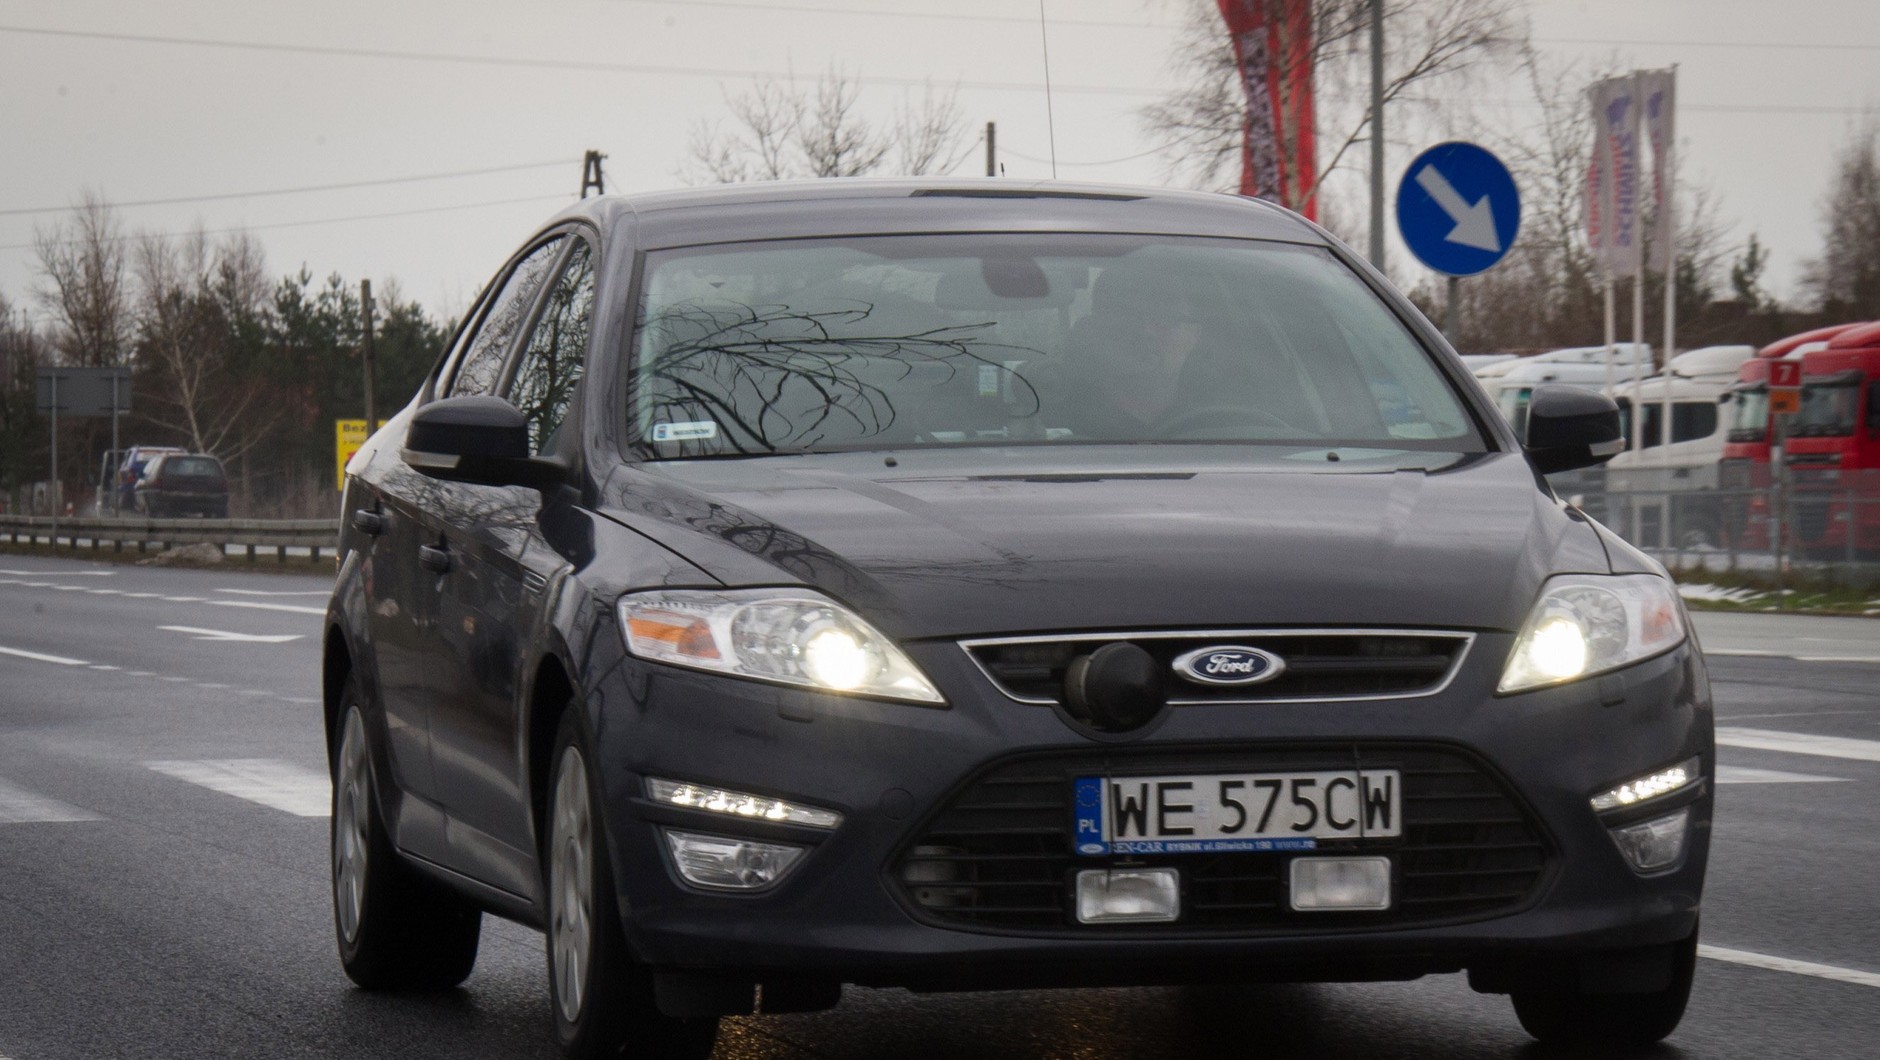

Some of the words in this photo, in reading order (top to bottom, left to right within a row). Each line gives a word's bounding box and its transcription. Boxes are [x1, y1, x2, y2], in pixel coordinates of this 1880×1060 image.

[1778, 364, 1792, 383] 7
[1206, 654, 1255, 673] Ford
[1112, 780, 1194, 837] WE
[1219, 775, 1393, 835] 575CW
[1079, 819, 1099, 833] PL
